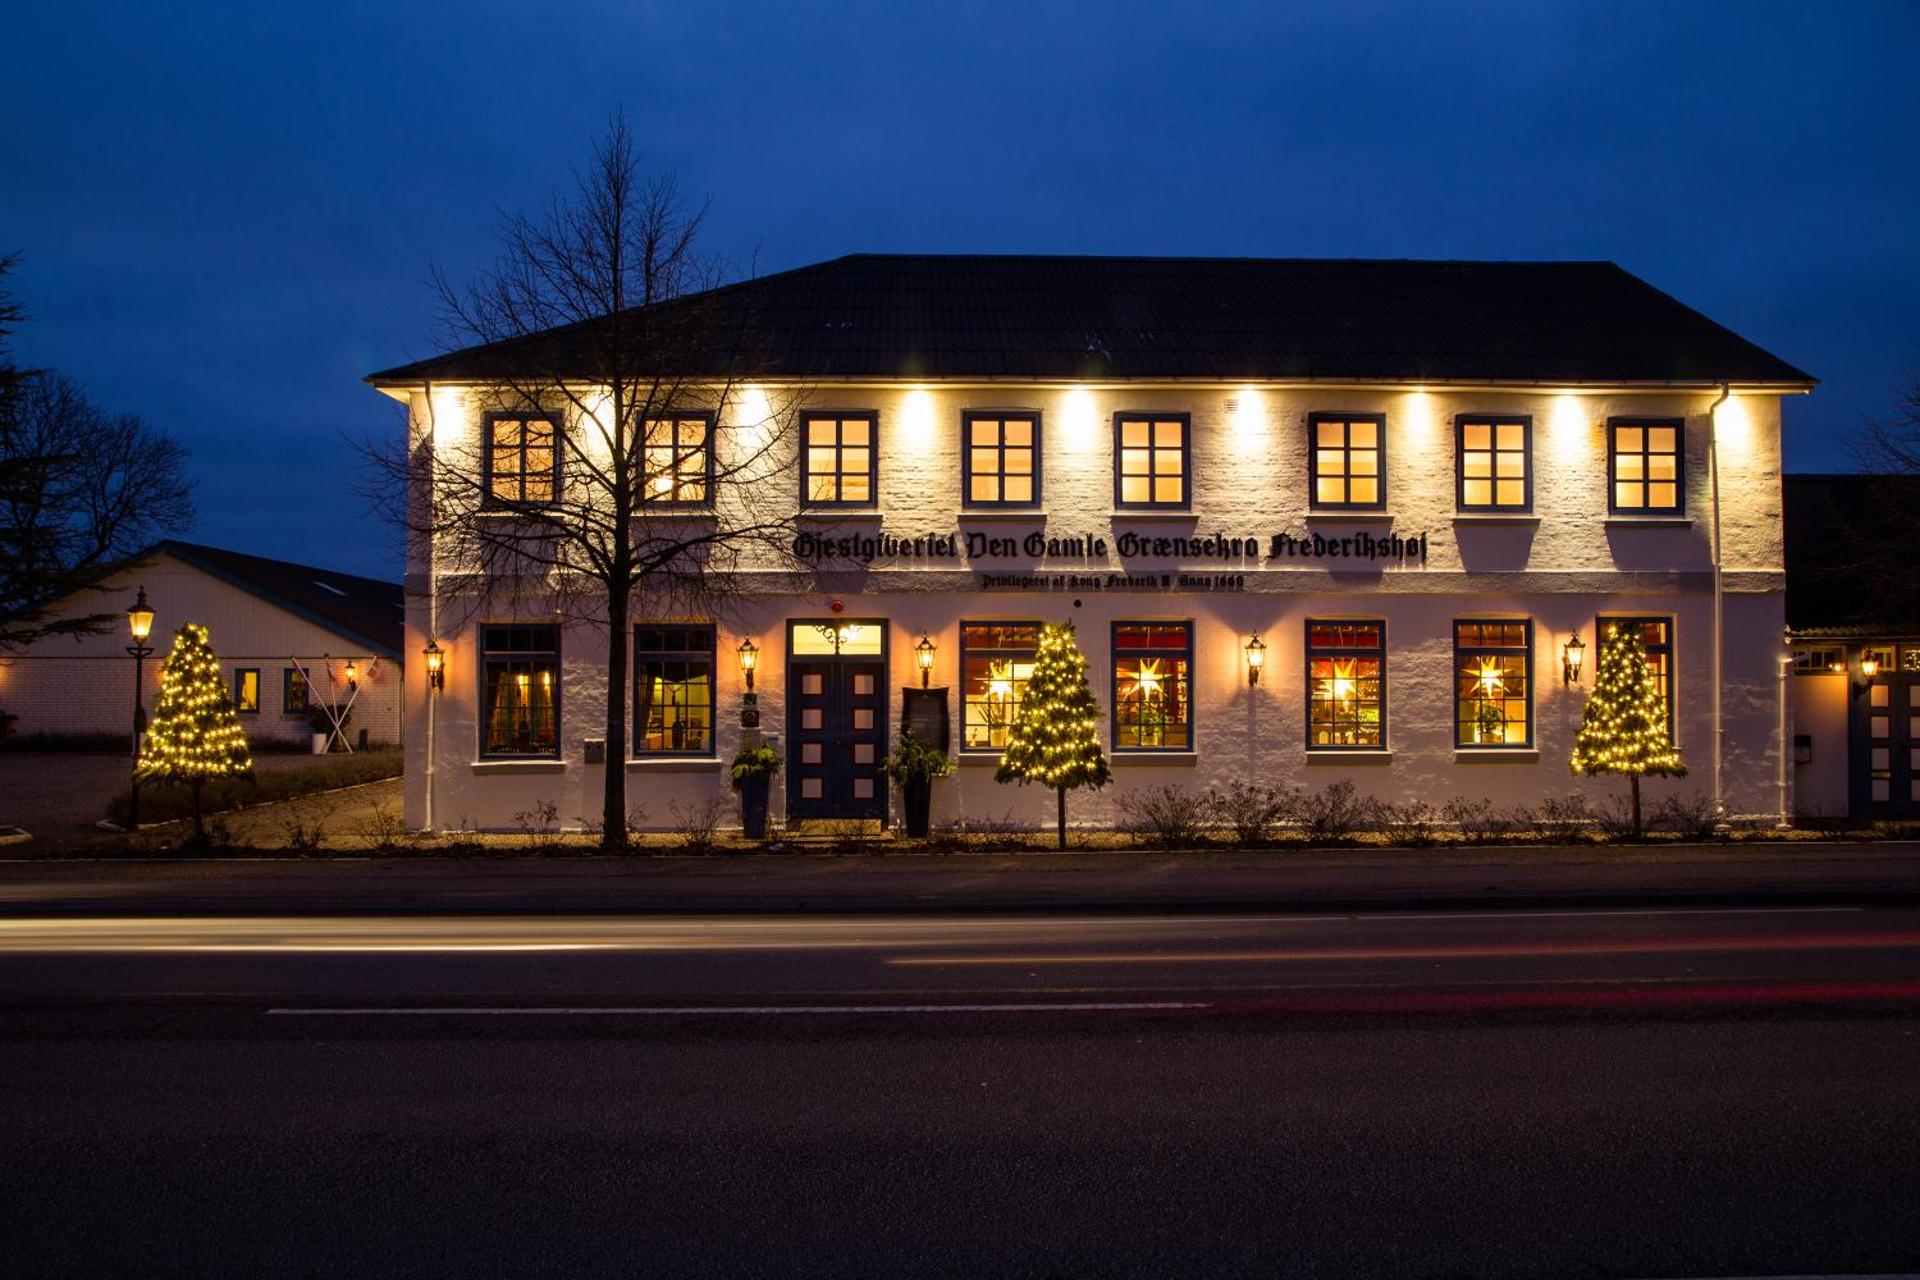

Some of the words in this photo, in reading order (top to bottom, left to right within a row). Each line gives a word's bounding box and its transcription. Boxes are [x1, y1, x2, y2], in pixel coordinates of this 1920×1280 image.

[966, 532, 1017, 558] Den
[1024, 532, 1108, 558] Gamle
[1117, 532, 1259, 560] Grænsekro
[1264, 531, 1427, 562] Frederikshøj
[1070, 574, 1100, 588] Kong
[1103, 574, 1157, 588] Frederik
[1177, 574, 1211, 587] Anno
